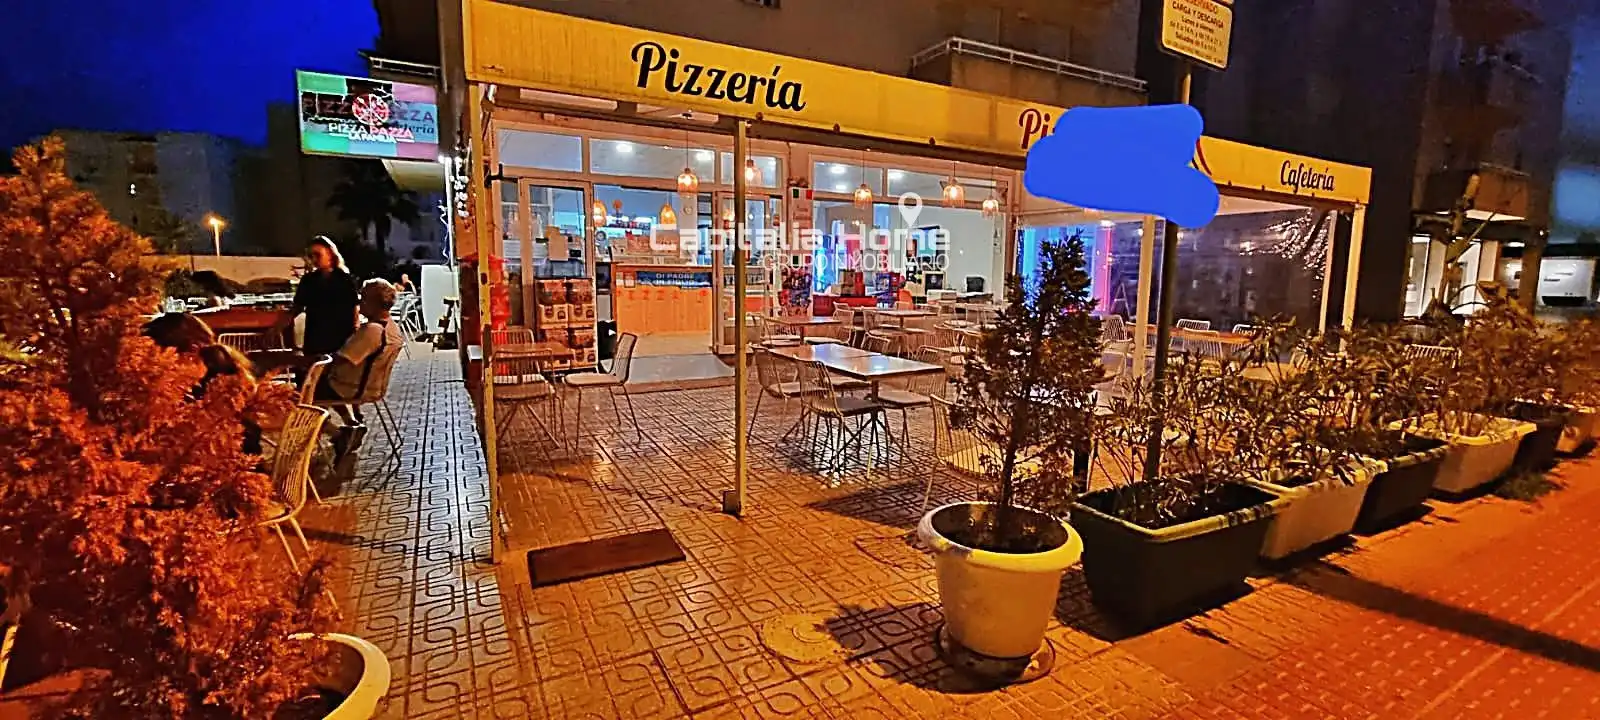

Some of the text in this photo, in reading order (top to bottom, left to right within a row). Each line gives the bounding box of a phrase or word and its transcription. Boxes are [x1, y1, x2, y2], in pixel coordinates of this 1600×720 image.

[1172, 1, 1191, 14] CARGA
[1197, 11, 1224, 28] DESCARGA
[631, 41, 806, 112] Pizzería
[328, 122, 415, 140] PIZZA PAZZA
[1280, 160, 1335, 194] Cafetería
